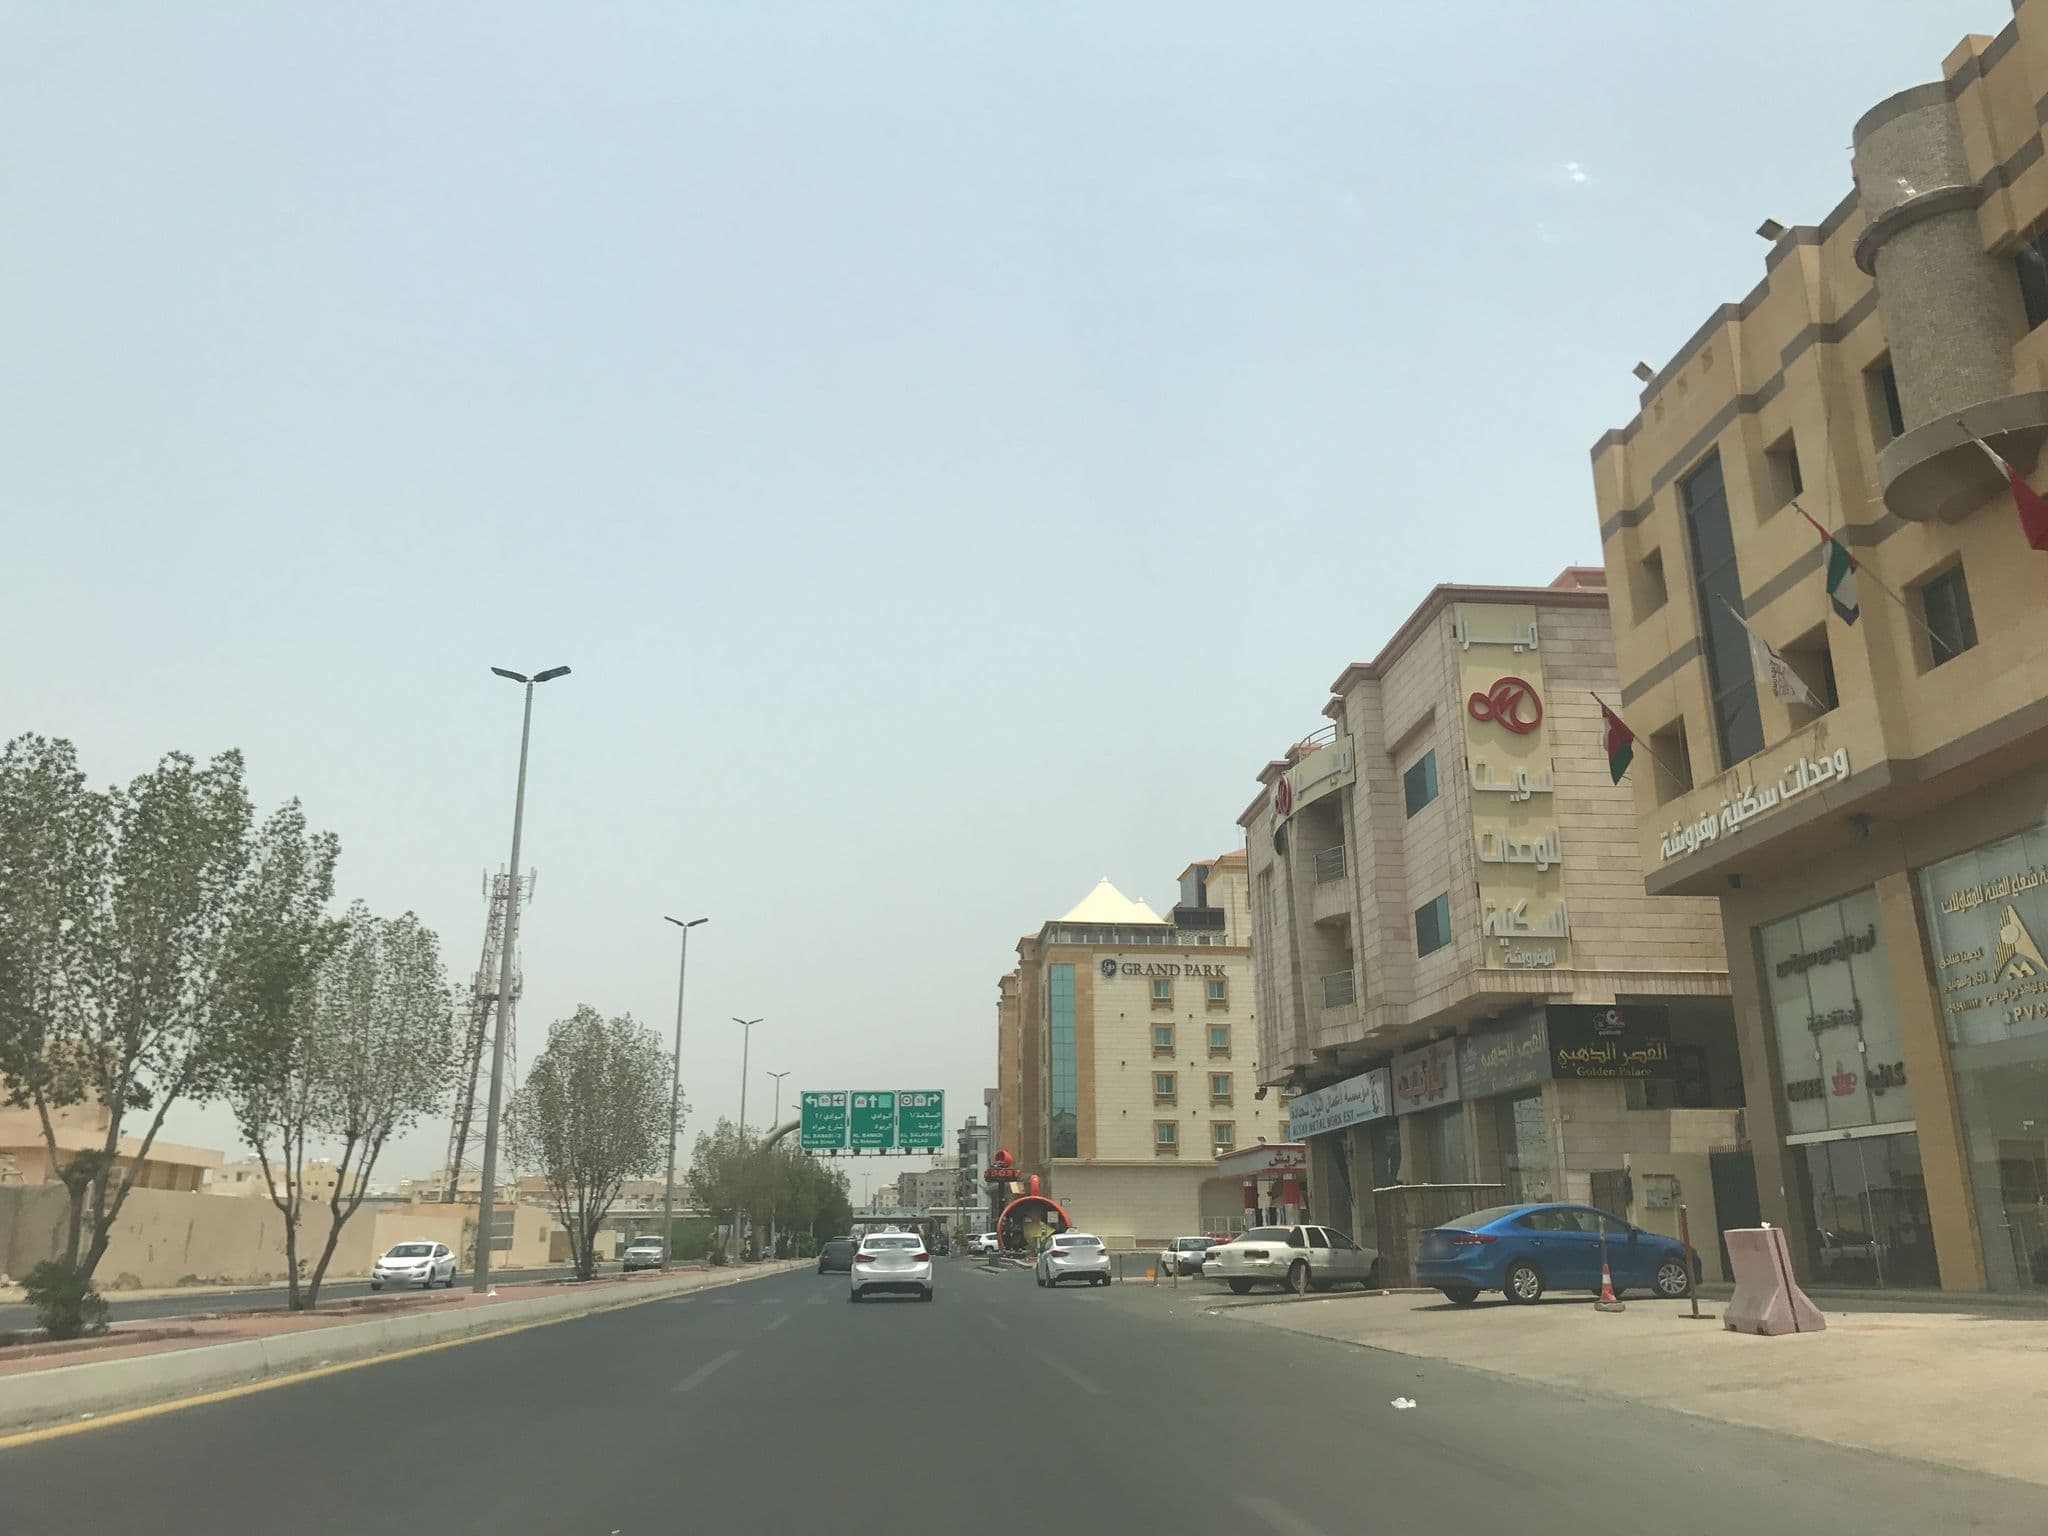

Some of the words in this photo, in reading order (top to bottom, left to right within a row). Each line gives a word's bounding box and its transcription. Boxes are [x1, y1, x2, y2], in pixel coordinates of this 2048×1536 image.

[1469, 758, 1553, 802] سويت
[1779, 747, 1850, 799] وحدات
[1720, 784, 1780, 833] سكنية
[1476, 826, 1561, 871] للوحدات
[1660, 811, 1720, 860] مفروشة
[1483, 899, 1569, 946] السكنية
[1121, 962, 1181, 976] GRAND
[1184, 964, 1226, 977] PARK
[1504, 946, 1556, 968] المفروشة
[1557, 1041, 1617, 1069] الذهبي
[1576, 1066, 1615, 1077] Golden
[1618, 1066, 1653, 1077] Palace
[1623, 1040, 1668, 1066] القصر
